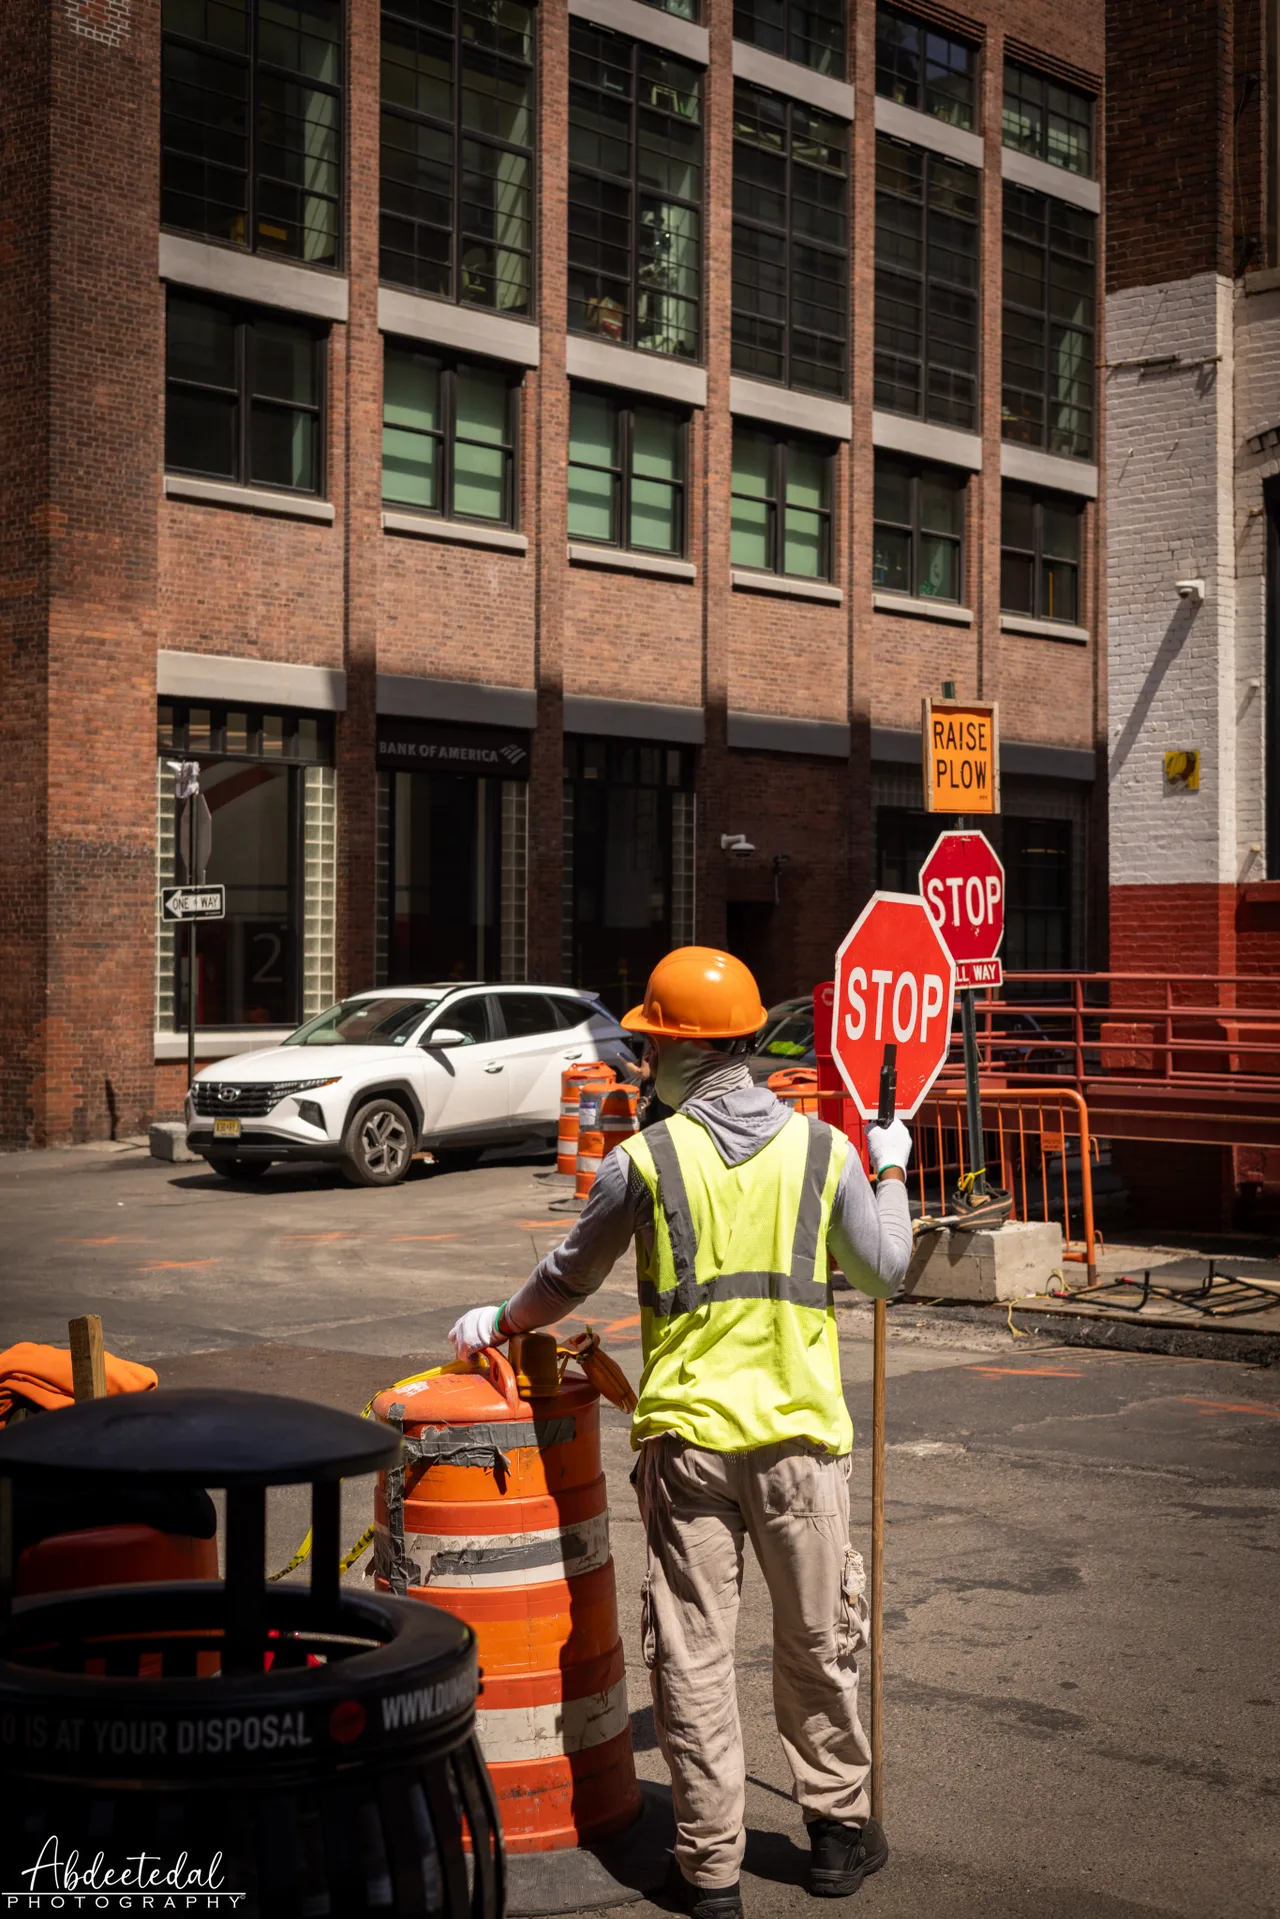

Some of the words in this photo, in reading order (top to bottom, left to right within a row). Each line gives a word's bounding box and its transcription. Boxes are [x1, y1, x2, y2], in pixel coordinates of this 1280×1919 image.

[933, 720, 987, 751] RAISE
[379, 741, 417, 756] BANK
[419, 744, 437, 757] OF
[438, 746, 499, 762] AMERICA
[936, 759, 986, 789] PLOW
[172, 898, 190, 911] ONE
[200, 896, 218, 908] WAY
[927, 876, 1001, 928] STOP
[252, 932, 283, 983] 2
[956, 966, 970, 982] LL
[973, 964, 996, 981] WAY
[845, 966, 943, 1043] STOP
[24, 1712, 48, 1749] IS
[54, 1715, 86, 1752] AT
[92, 1717, 170, 1756] YOUR
[176, 1711, 312, 1755] DISPOSAL
